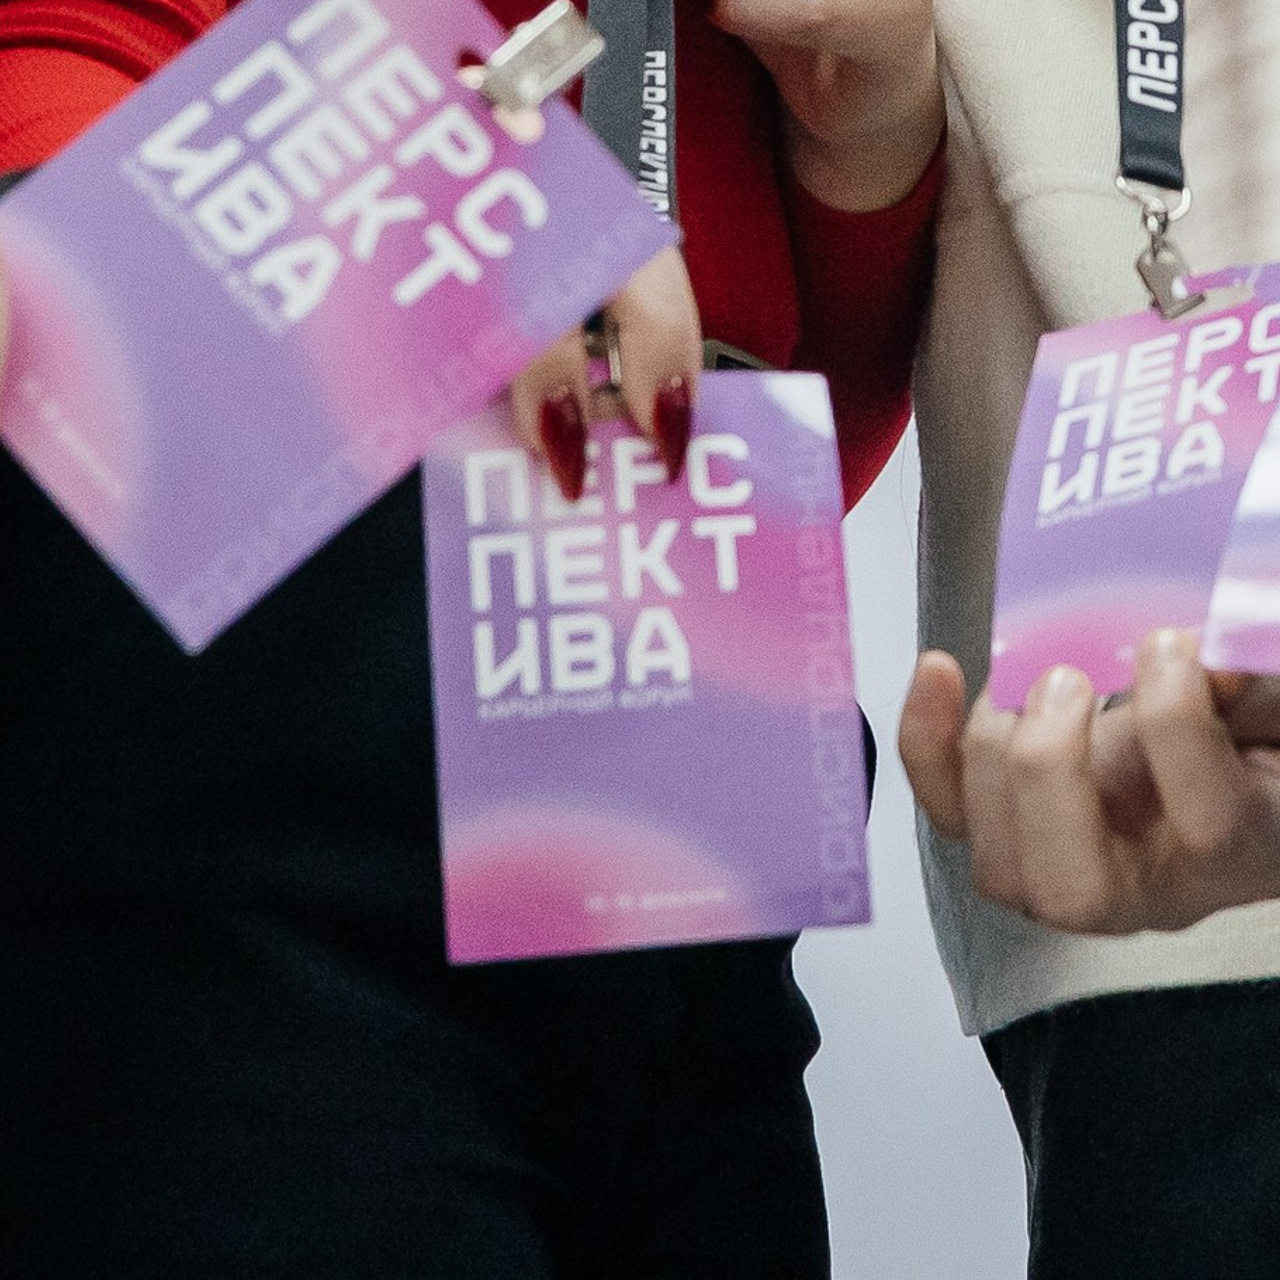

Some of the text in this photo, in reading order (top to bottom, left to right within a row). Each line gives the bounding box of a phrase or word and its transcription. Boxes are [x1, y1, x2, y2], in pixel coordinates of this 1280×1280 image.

[137, 100, 343, 321] ИВА
[213, 40, 483, 307] ПЕКТ
[1037, 420, 1226, 516] ИВА
[467, 512, 758, 613] ПЕКТ
[472, 606, 693, 701] ИВА
